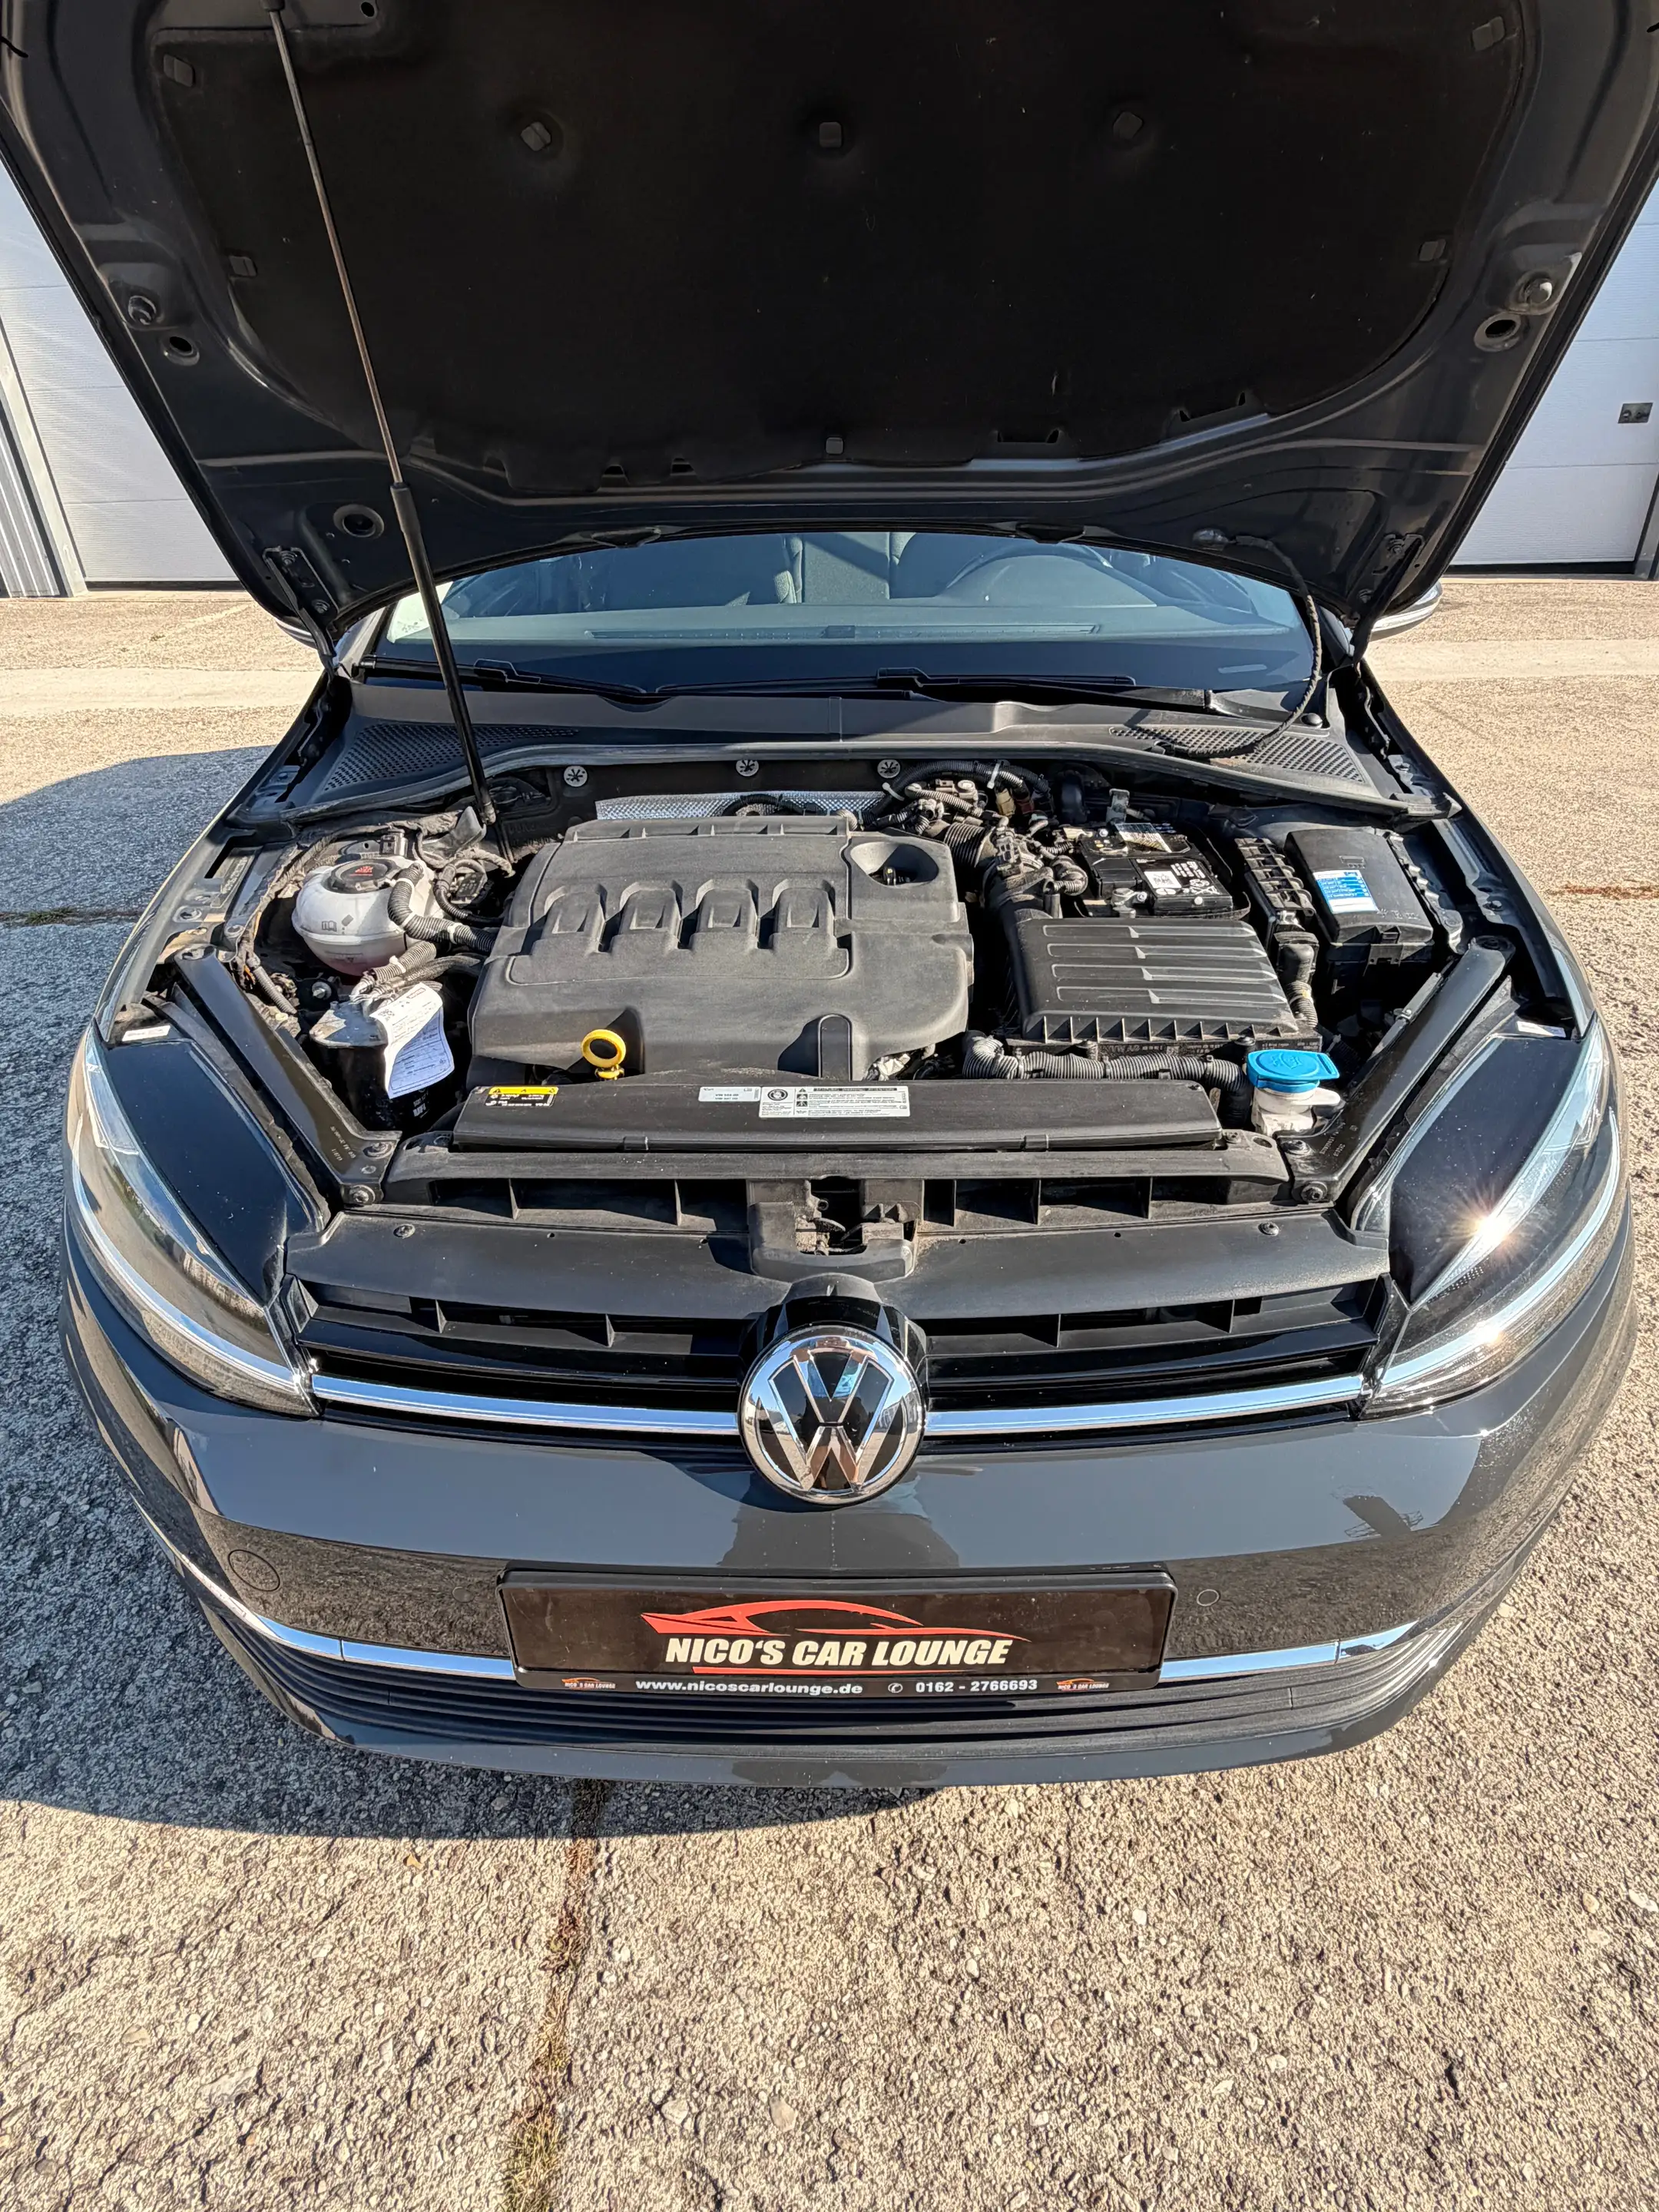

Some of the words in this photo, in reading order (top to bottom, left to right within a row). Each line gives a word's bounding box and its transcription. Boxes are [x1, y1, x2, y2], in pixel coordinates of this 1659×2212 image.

[754, 1348, 907, 1492] VW
[665, 1637, 786, 1665] NICO'S
[792, 1640, 867, 1666] CAR
[871, 1639, 1013, 1666] LOUNGE
[635, 1680, 863, 1696] www.nicoscarlounge.de
[916, 1681, 953, 1693] 0162
[970, 1679, 1038, 1692] 2766693
